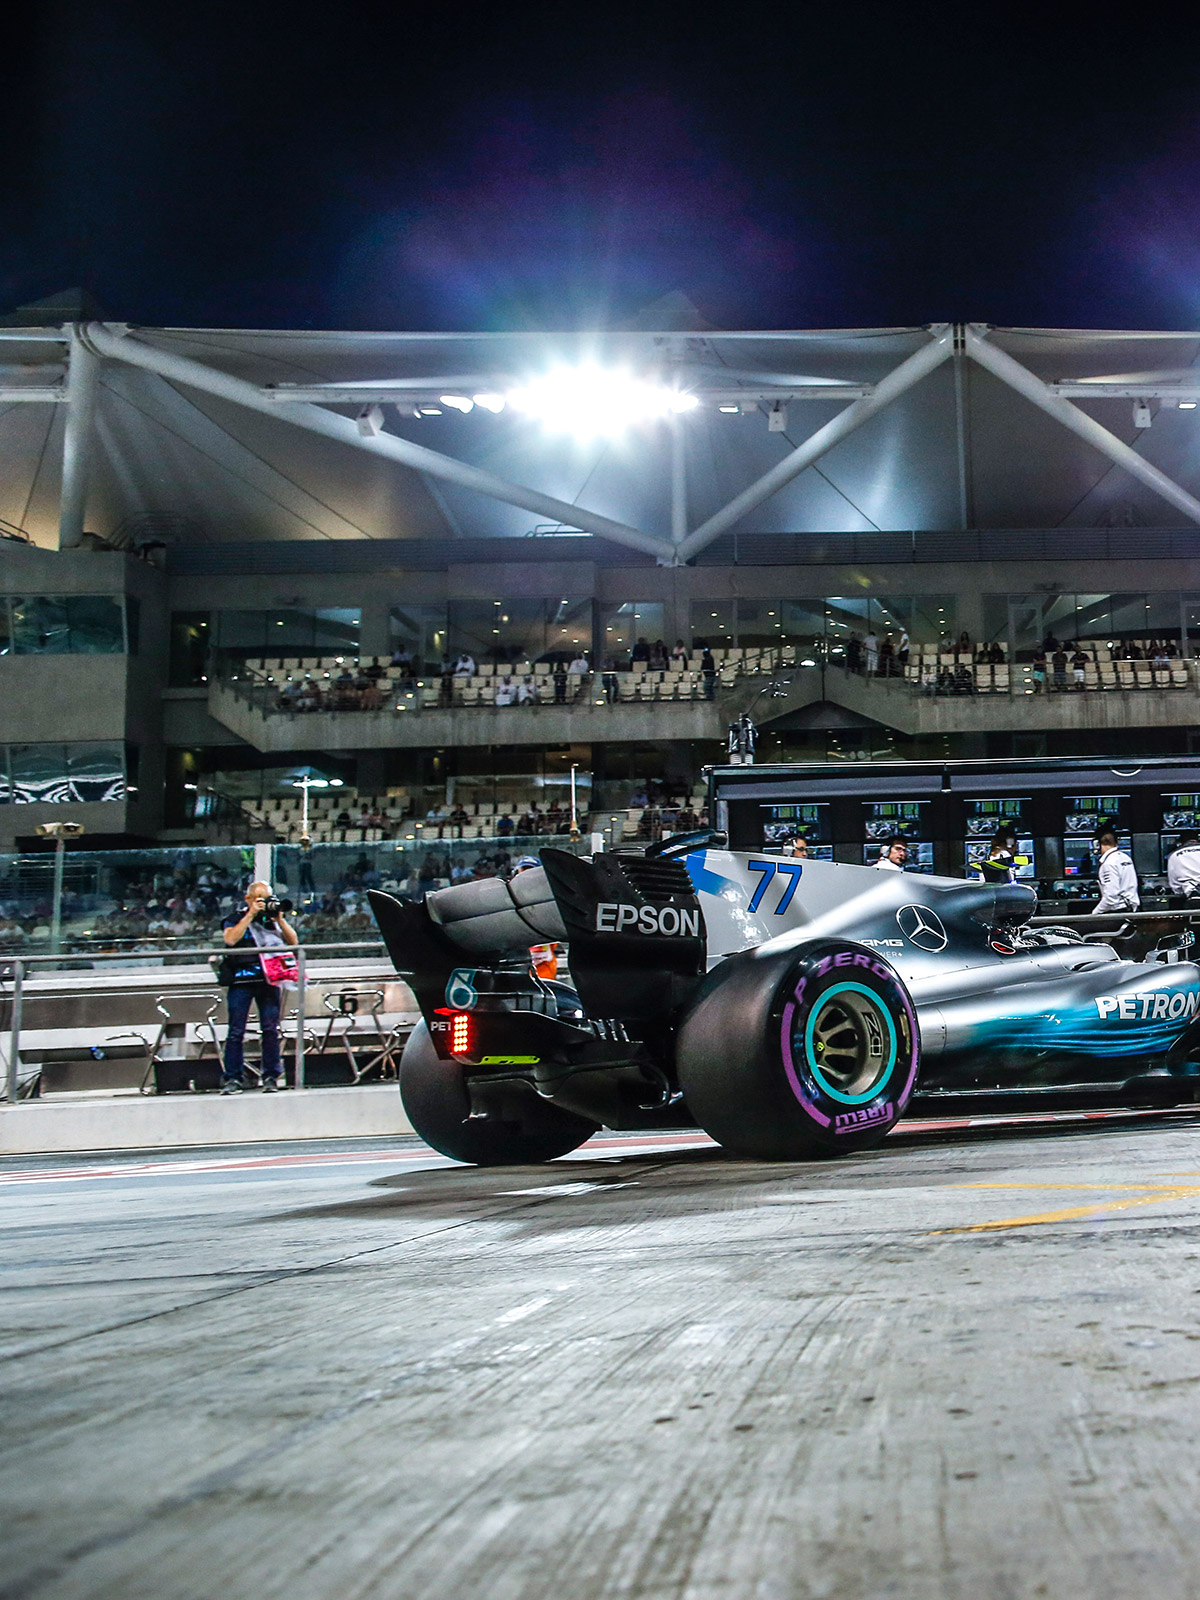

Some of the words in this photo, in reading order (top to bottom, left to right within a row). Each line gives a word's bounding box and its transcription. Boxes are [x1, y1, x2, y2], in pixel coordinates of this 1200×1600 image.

[747, 859, 803, 916] 77
[596, 902, 699, 937] EPSON
[861, 938, 904, 947] AMG
[794, 976, 808, 1004] P
[816, 952, 891, 981] ZERO
[835, 1102, 894, 1134] PIRELLI
